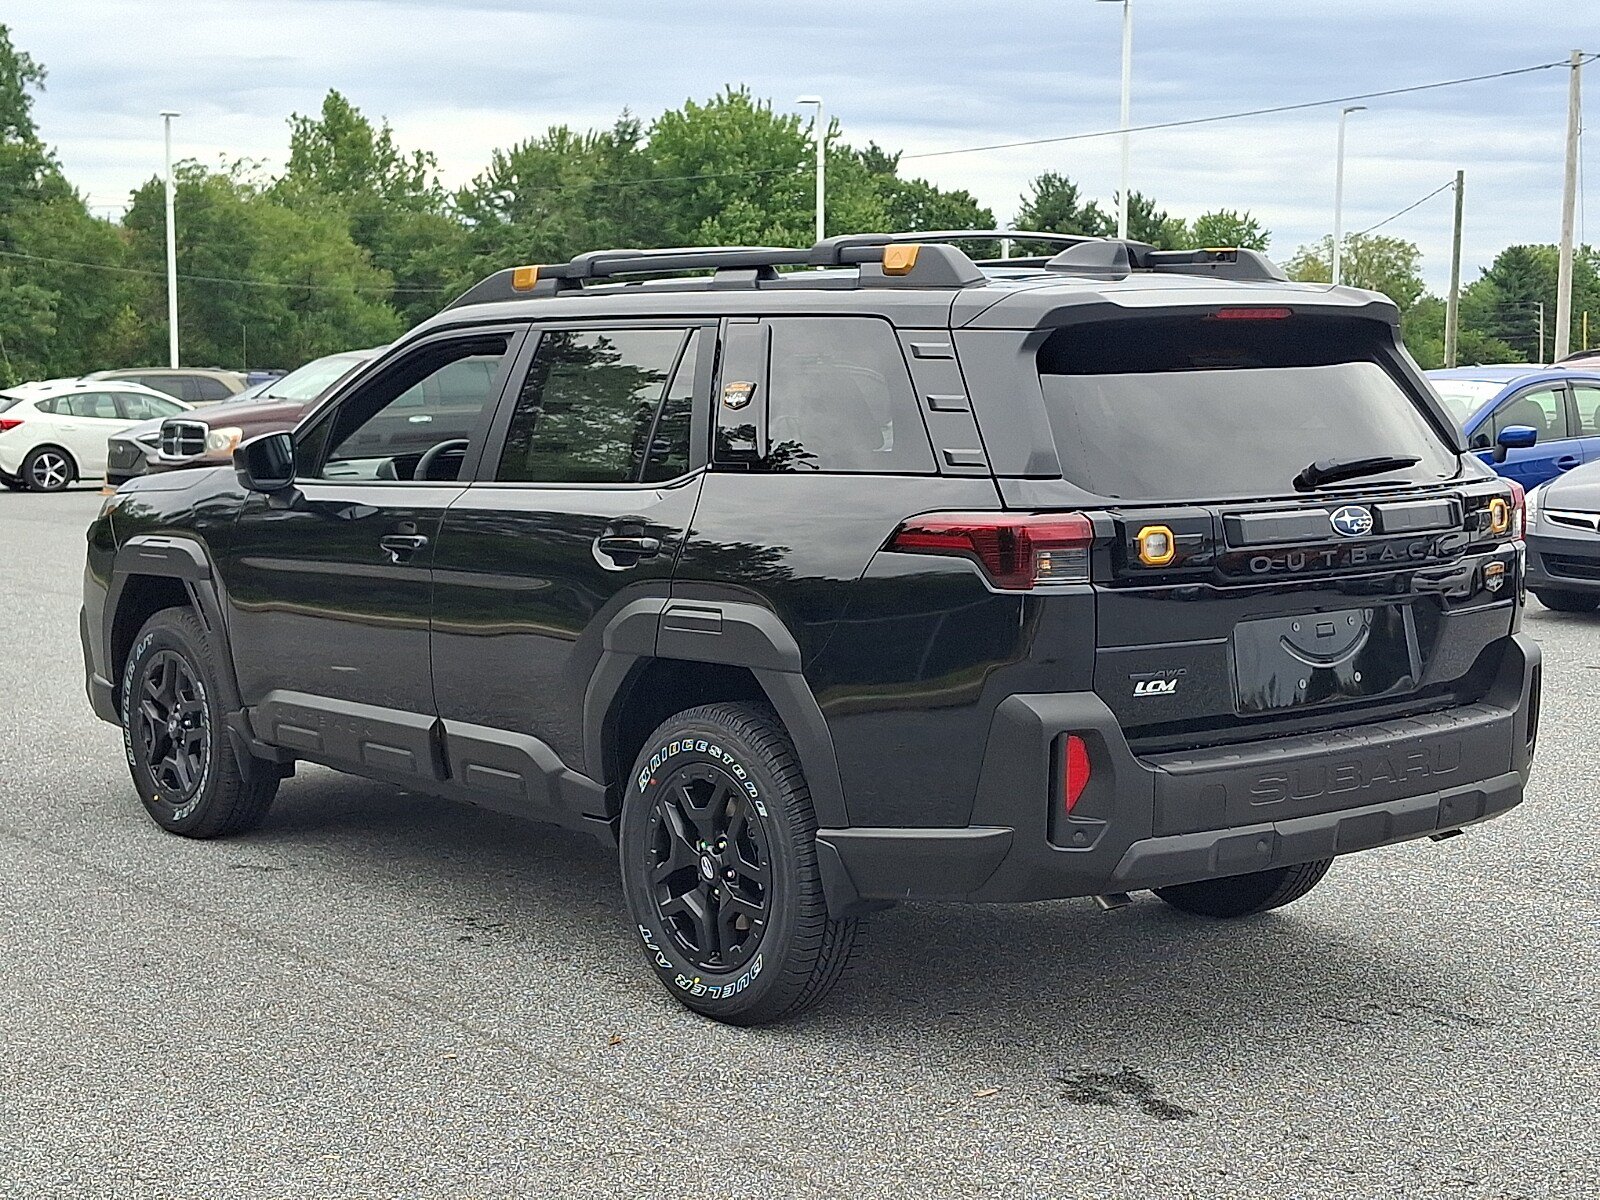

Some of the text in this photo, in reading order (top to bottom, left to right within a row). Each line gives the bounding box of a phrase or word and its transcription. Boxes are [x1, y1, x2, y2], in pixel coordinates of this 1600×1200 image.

[1250, 541, 1451, 573] OUTBACK
[1134, 678, 1178, 694] LCM
[1153, 668, 1187, 677] AWD
[637, 739, 768, 818] BRIDGESTONE
[1250, 741, 1462, 806] SUBARU
[674, 953, 764, 999] DUELER
